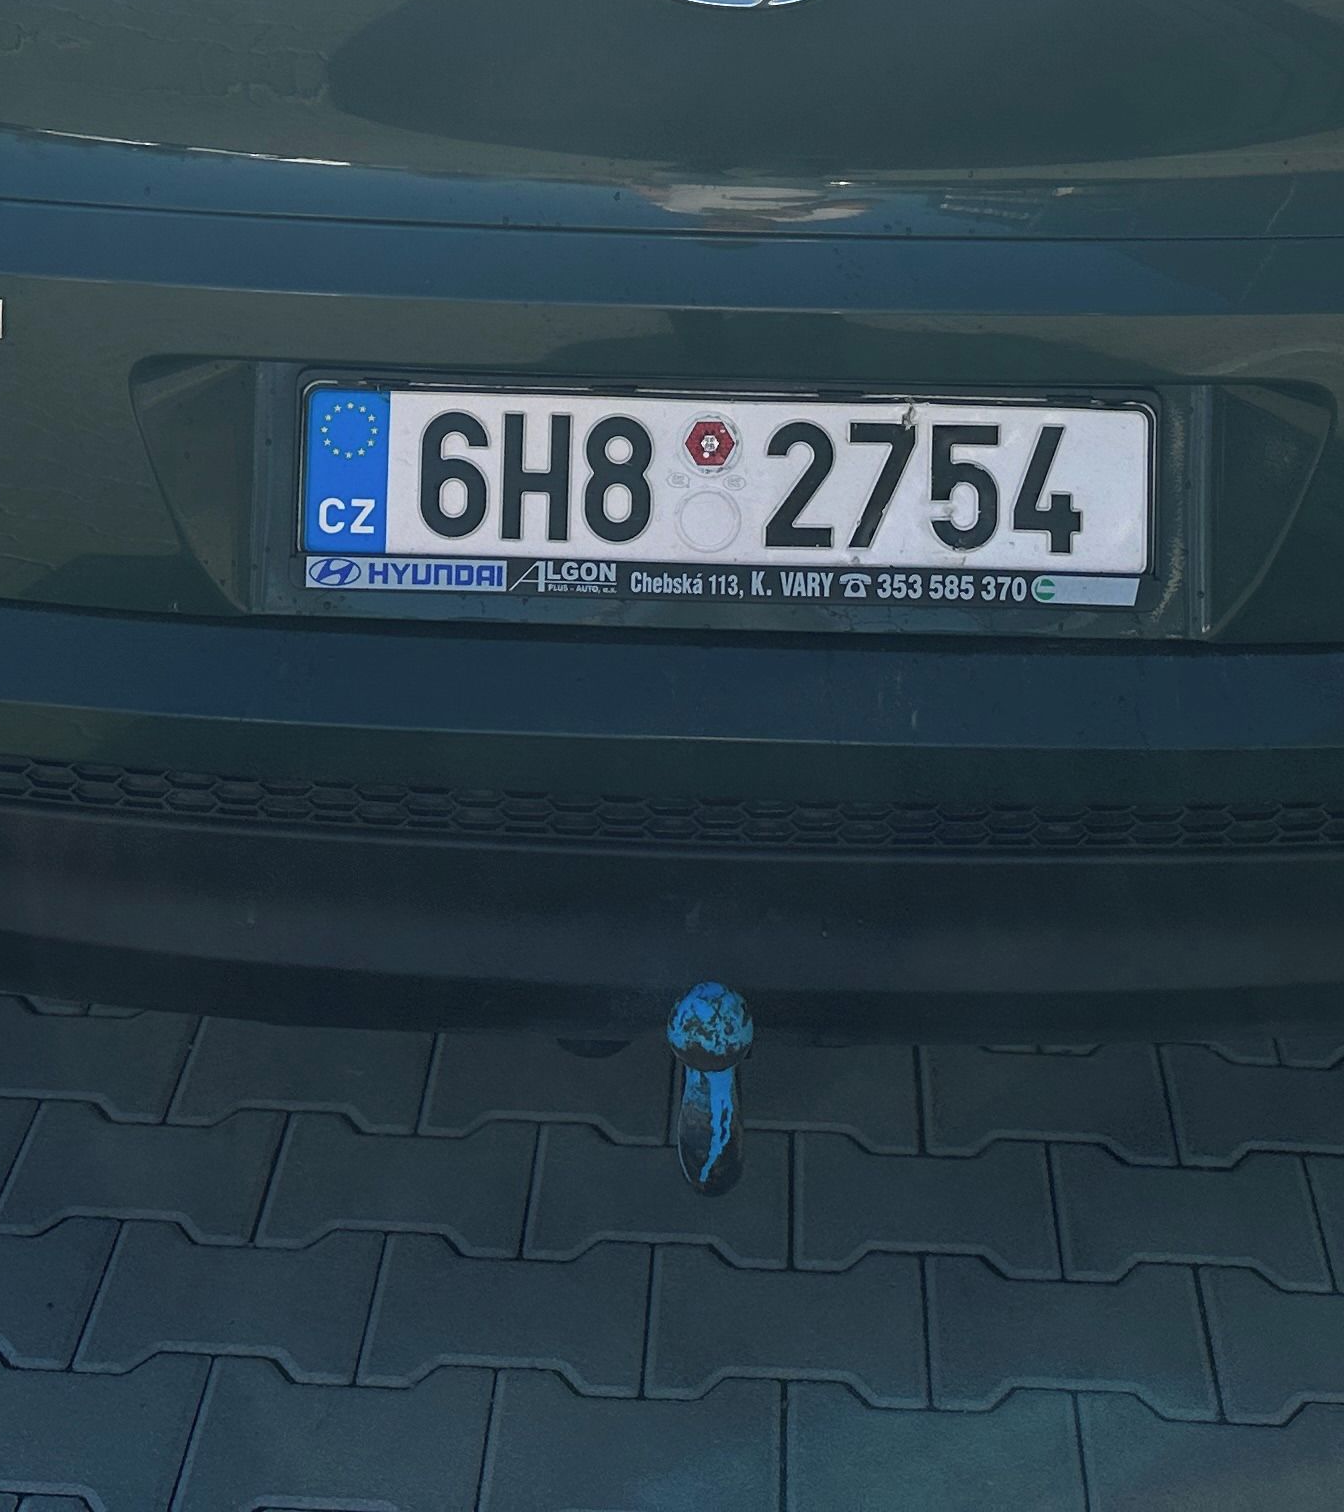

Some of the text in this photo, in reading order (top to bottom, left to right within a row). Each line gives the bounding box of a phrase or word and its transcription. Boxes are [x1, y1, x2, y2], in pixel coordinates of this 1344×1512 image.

[419, 411, 1083, 554] 6H8 2754
[317, 497, 376, 535] CZ
[368, 561, 504, 587] HYUNDAI
[508, 560, 617, 593] ALGON
[630, 570, 1027, 602] Chebská 113, K. VARY 353 585 370
